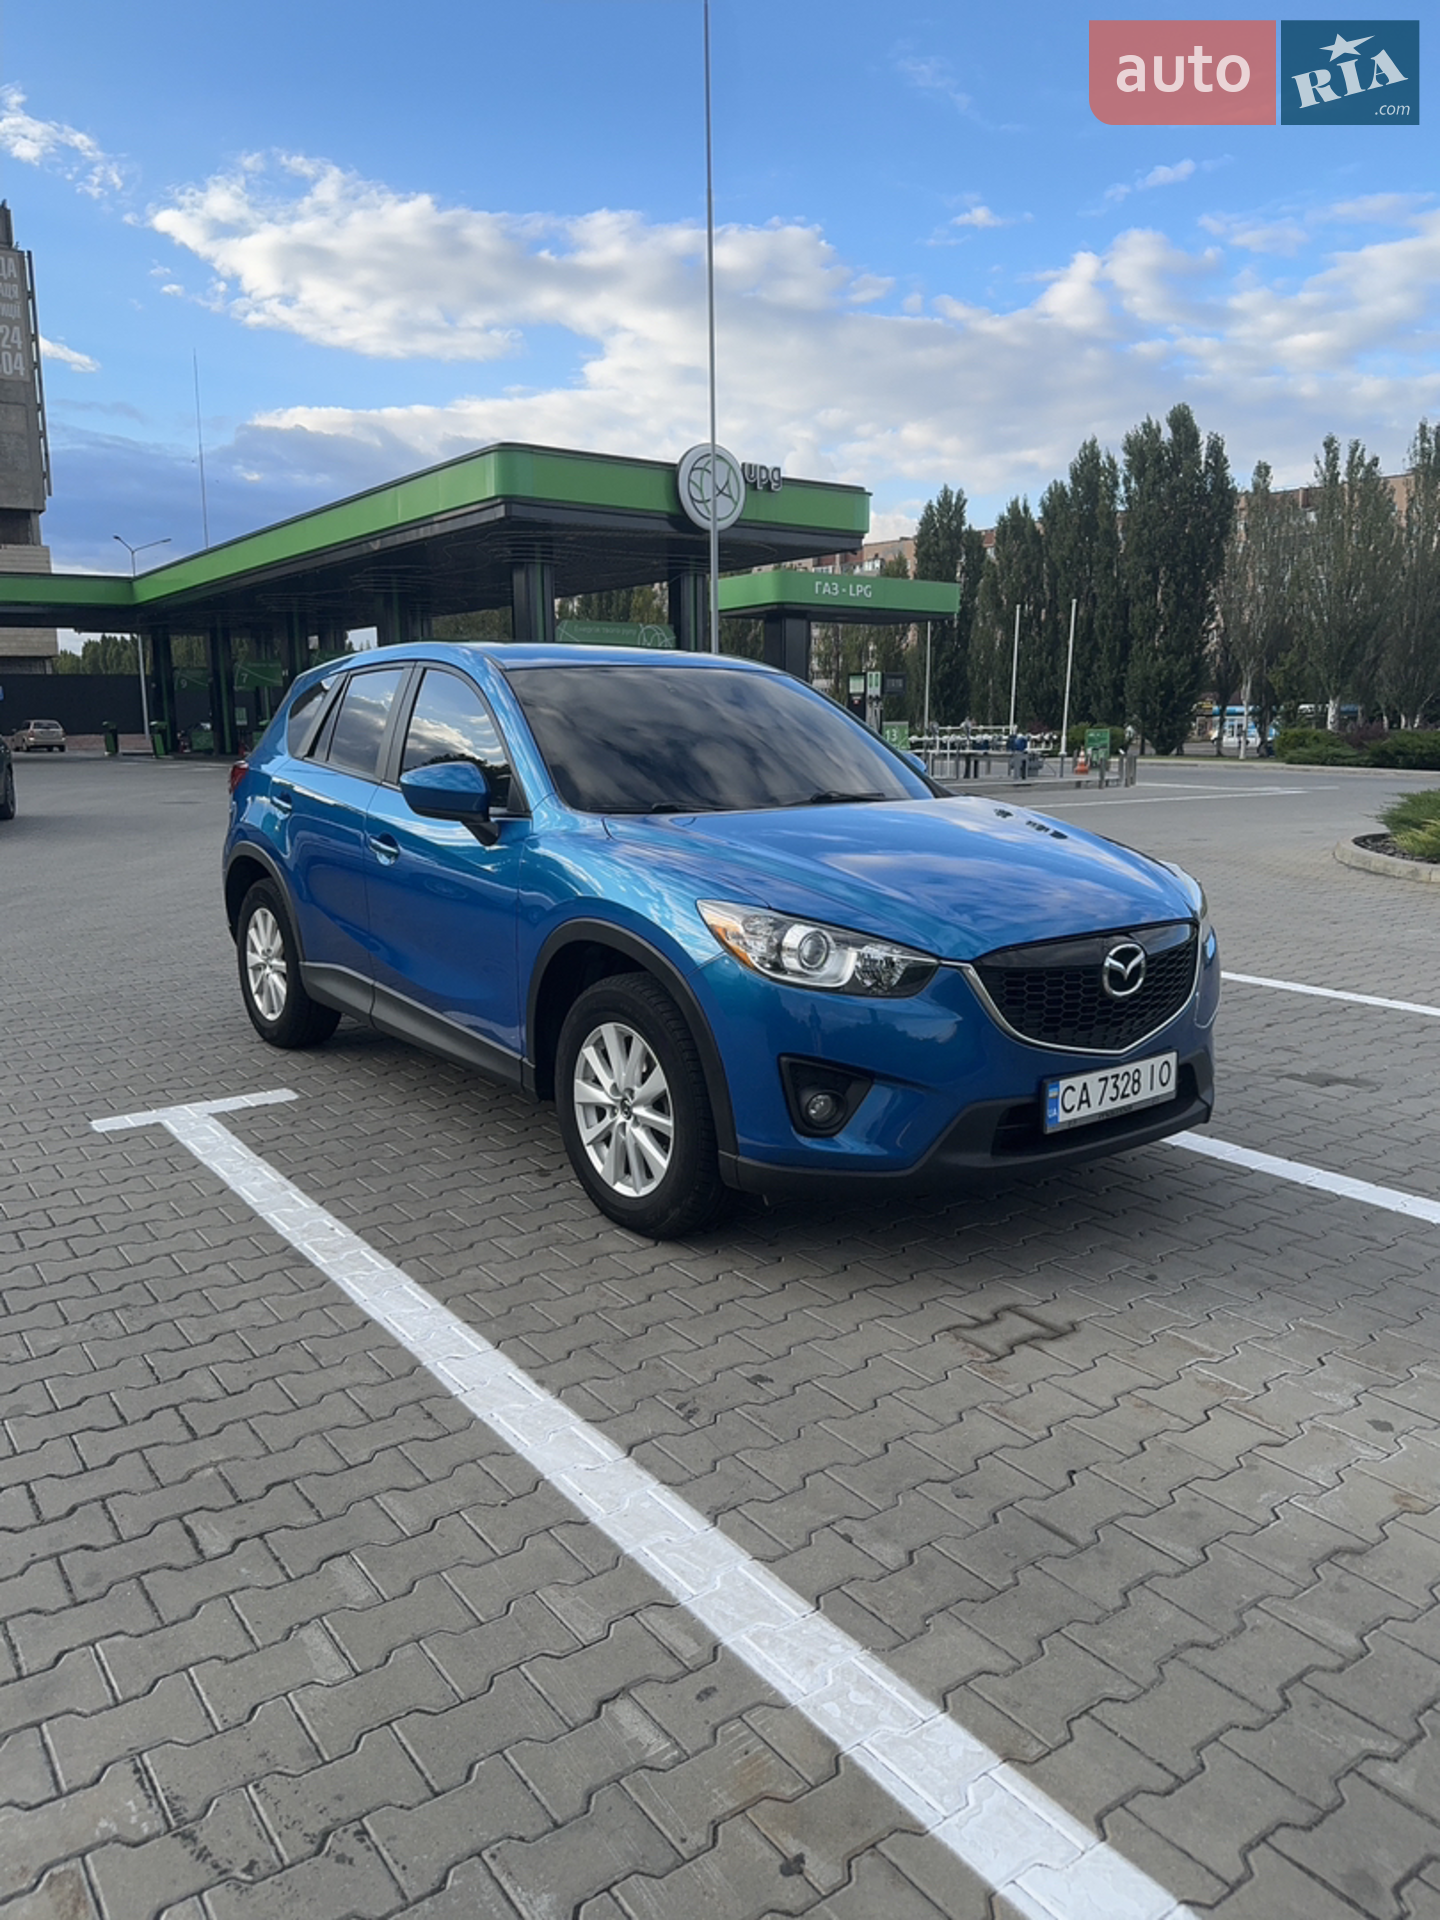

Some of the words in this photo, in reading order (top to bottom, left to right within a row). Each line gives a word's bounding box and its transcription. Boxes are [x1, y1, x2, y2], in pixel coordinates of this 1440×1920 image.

[0, 351, 25, 376] 04
[741, 462, 782, 491] upg
[815, 581, 839, 596] ГАЗ
[849, 584, 872, 598] LPG
[1061, 1081, 1092, 1114] CA
[1098, 1068, 1142, 1106] 7328
